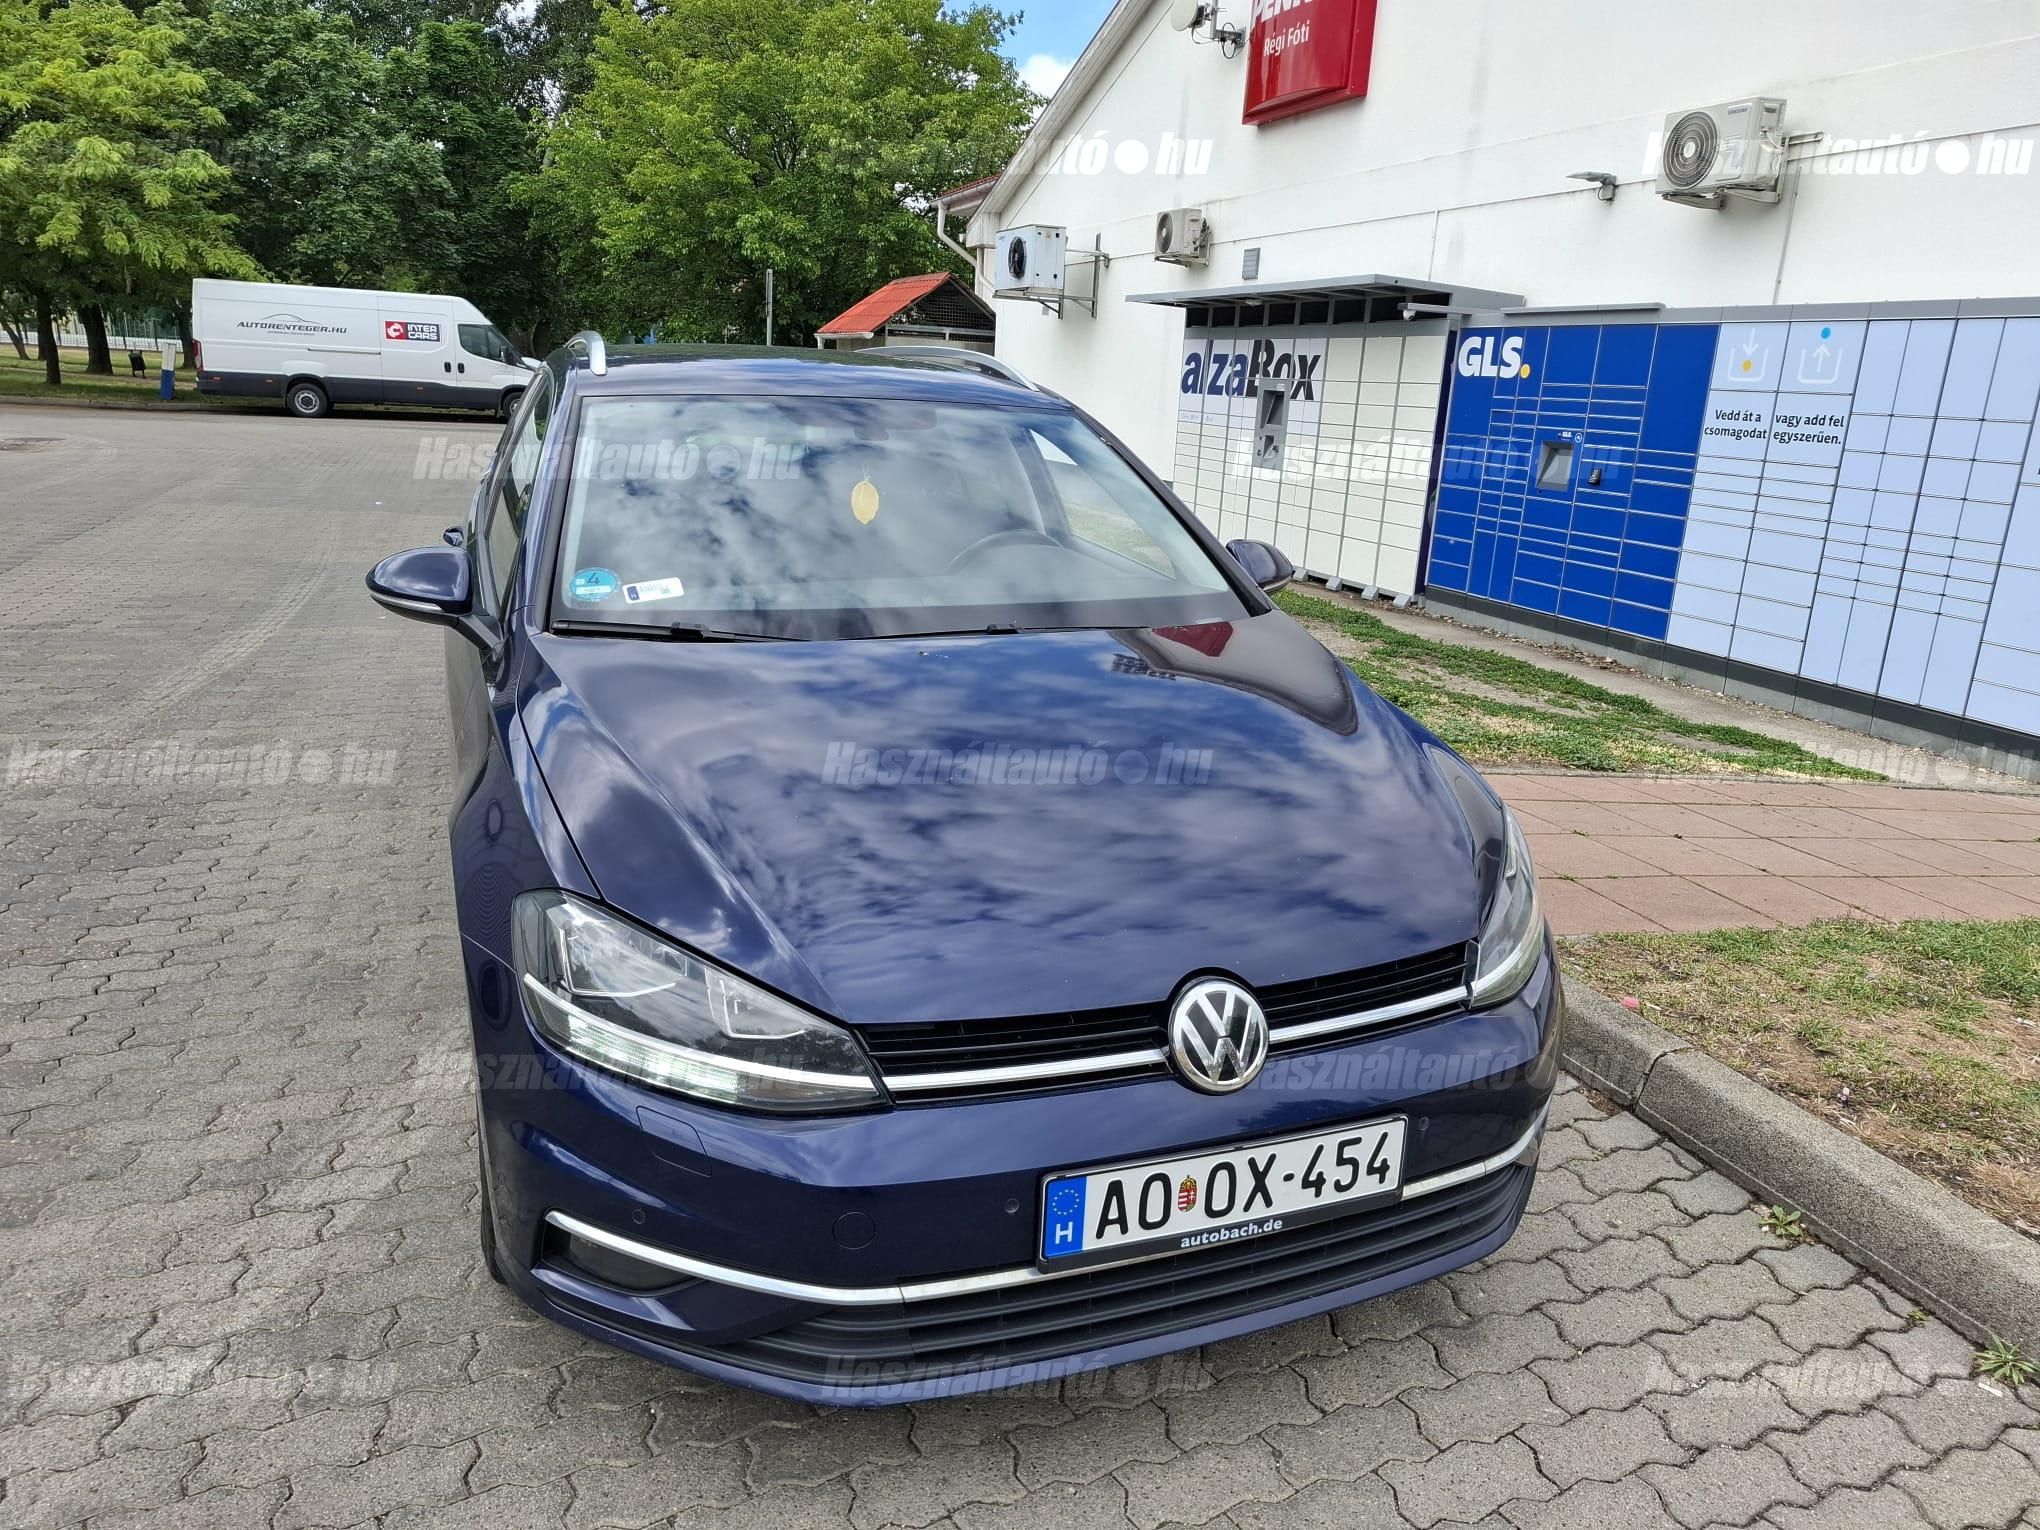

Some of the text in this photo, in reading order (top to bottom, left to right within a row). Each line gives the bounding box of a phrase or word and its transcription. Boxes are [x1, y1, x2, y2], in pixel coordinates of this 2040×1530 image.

[1264, 20, 1311, 57] Régi Fóti
[407, 323, 437, 333] INTER
[407, 331, 438, 340] CARS
[1181, 339, 1321, 401] alzaBox
[1715, 409, 1762, 422] Vedd át a
[1775, 414, 1845, 428] vagy add fel
[1704, 426, 1767, 441] csomagodat
[1773, 431, 1842, 445] egyszerűen.
[587, 572, 601, 585] 4
[1096, 1131, 1391, 1240] AO OX-454
[1054, 1221, 1073, 1245] H
[1180, 1218, 1283, 1248] autobach.de
